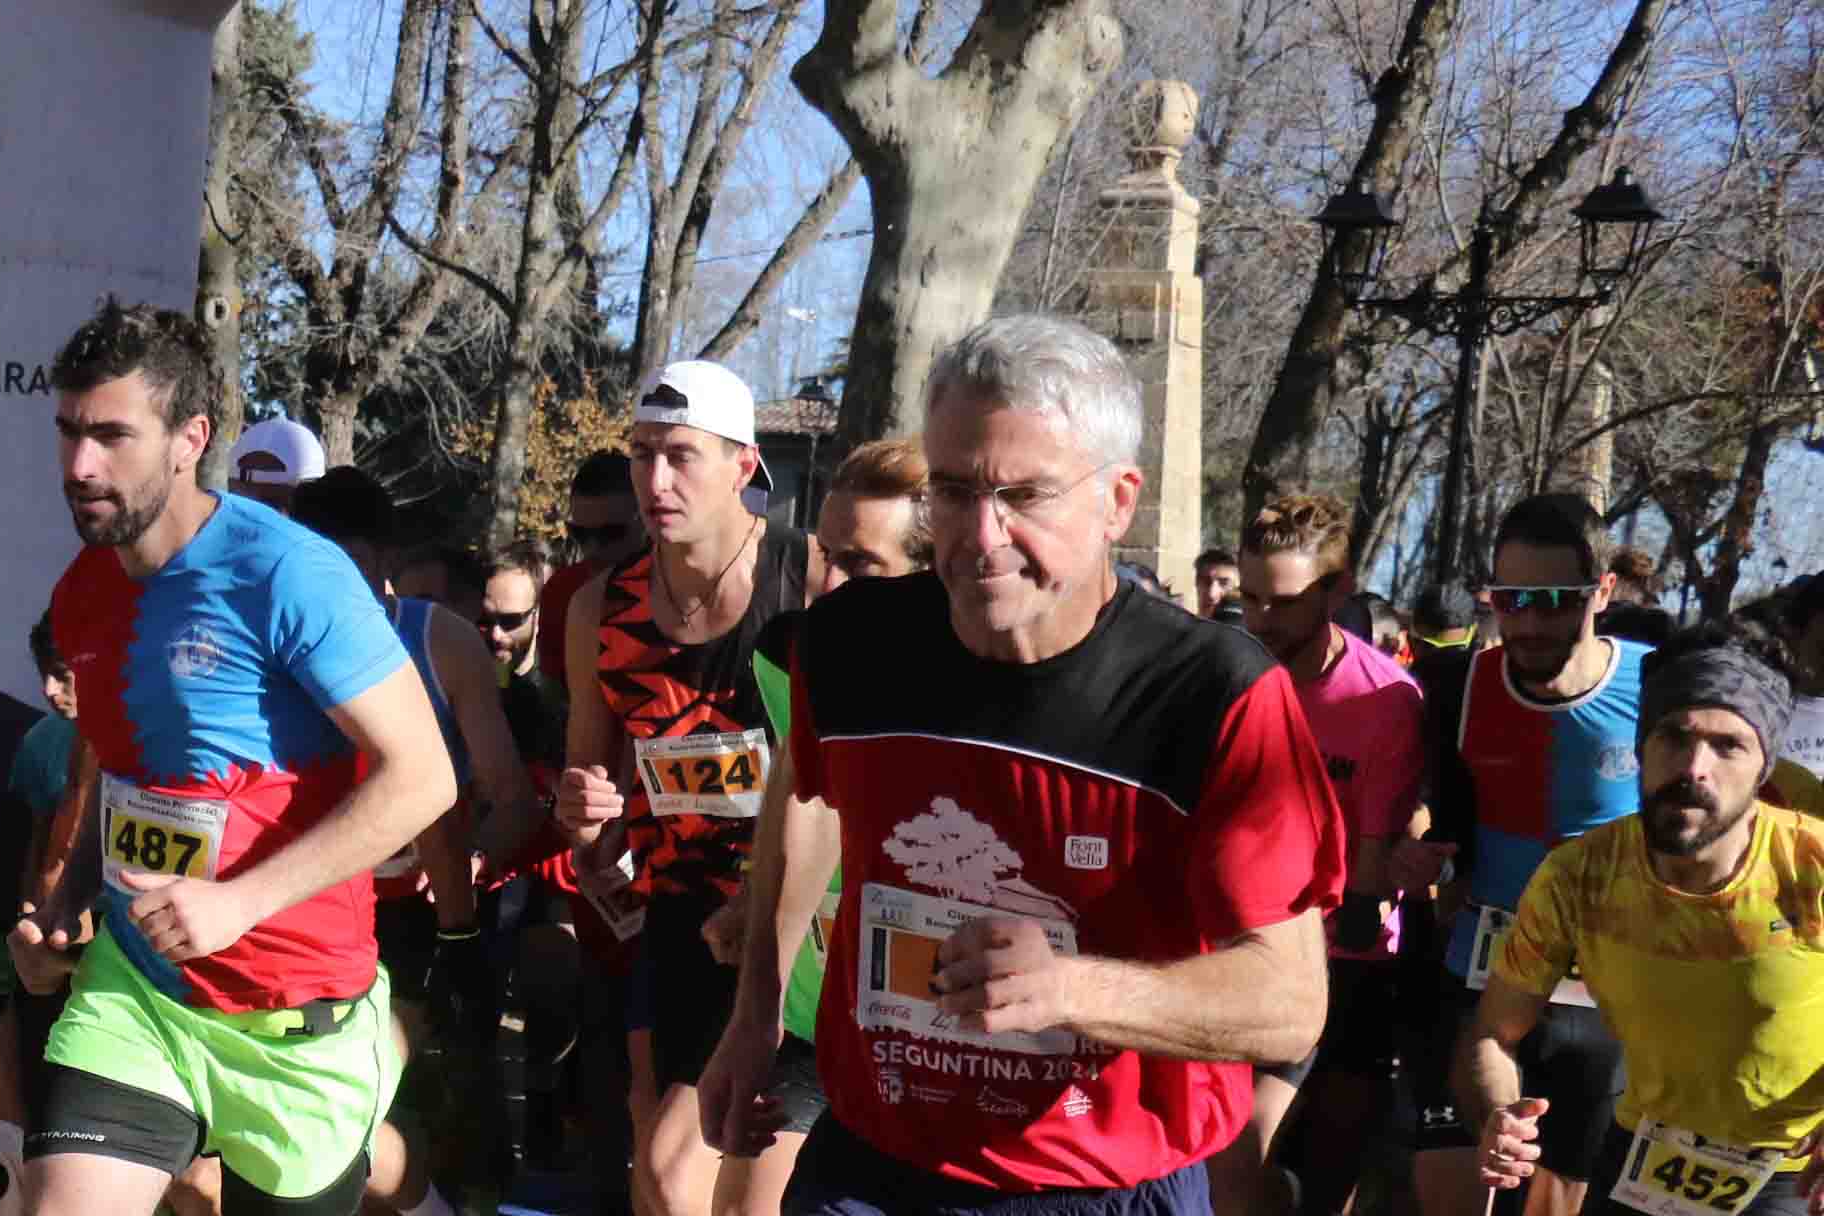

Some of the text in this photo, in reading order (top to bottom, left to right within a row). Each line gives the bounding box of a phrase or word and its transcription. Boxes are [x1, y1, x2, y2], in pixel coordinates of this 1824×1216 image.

[667, 754, 756, 795] 124
[115, 820, 202, 876] 487
[872, 1040, 1099, 1081] SEGUNTINA 2024
[1653, 1155, 1750, 1211] 452
